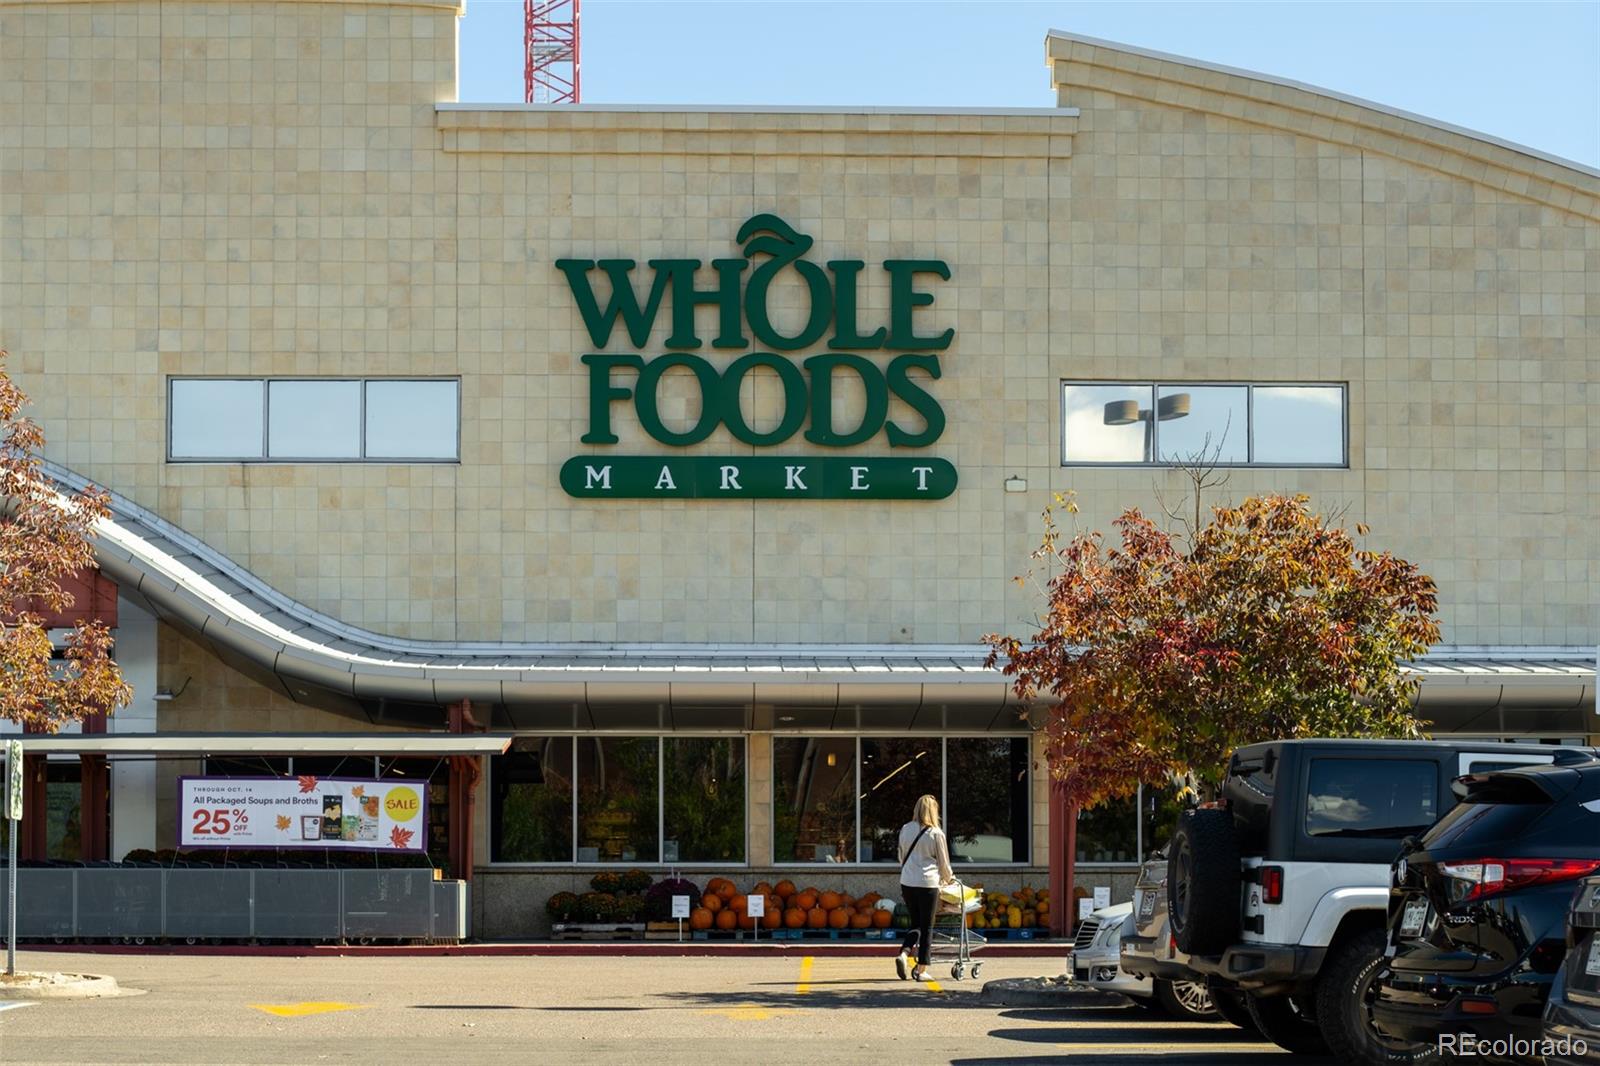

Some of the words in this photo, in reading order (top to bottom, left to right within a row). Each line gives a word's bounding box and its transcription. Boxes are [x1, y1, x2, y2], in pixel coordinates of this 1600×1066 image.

[555, 258, 955, 351] WHOLE
[580, 352, 946, 448] FOODS
[585, 465, 933, 491] MARKET
[193, 796, 205, 804] All
[206, 796, 247, 806] Packaged
[248, 796, 274, 806] Soups
[275, 796, 291, 804] and
[292, 796, 319, 804] Broths
[386, 799, 418, 810] SALE
[1449, 914, 1476, 924] RDX
